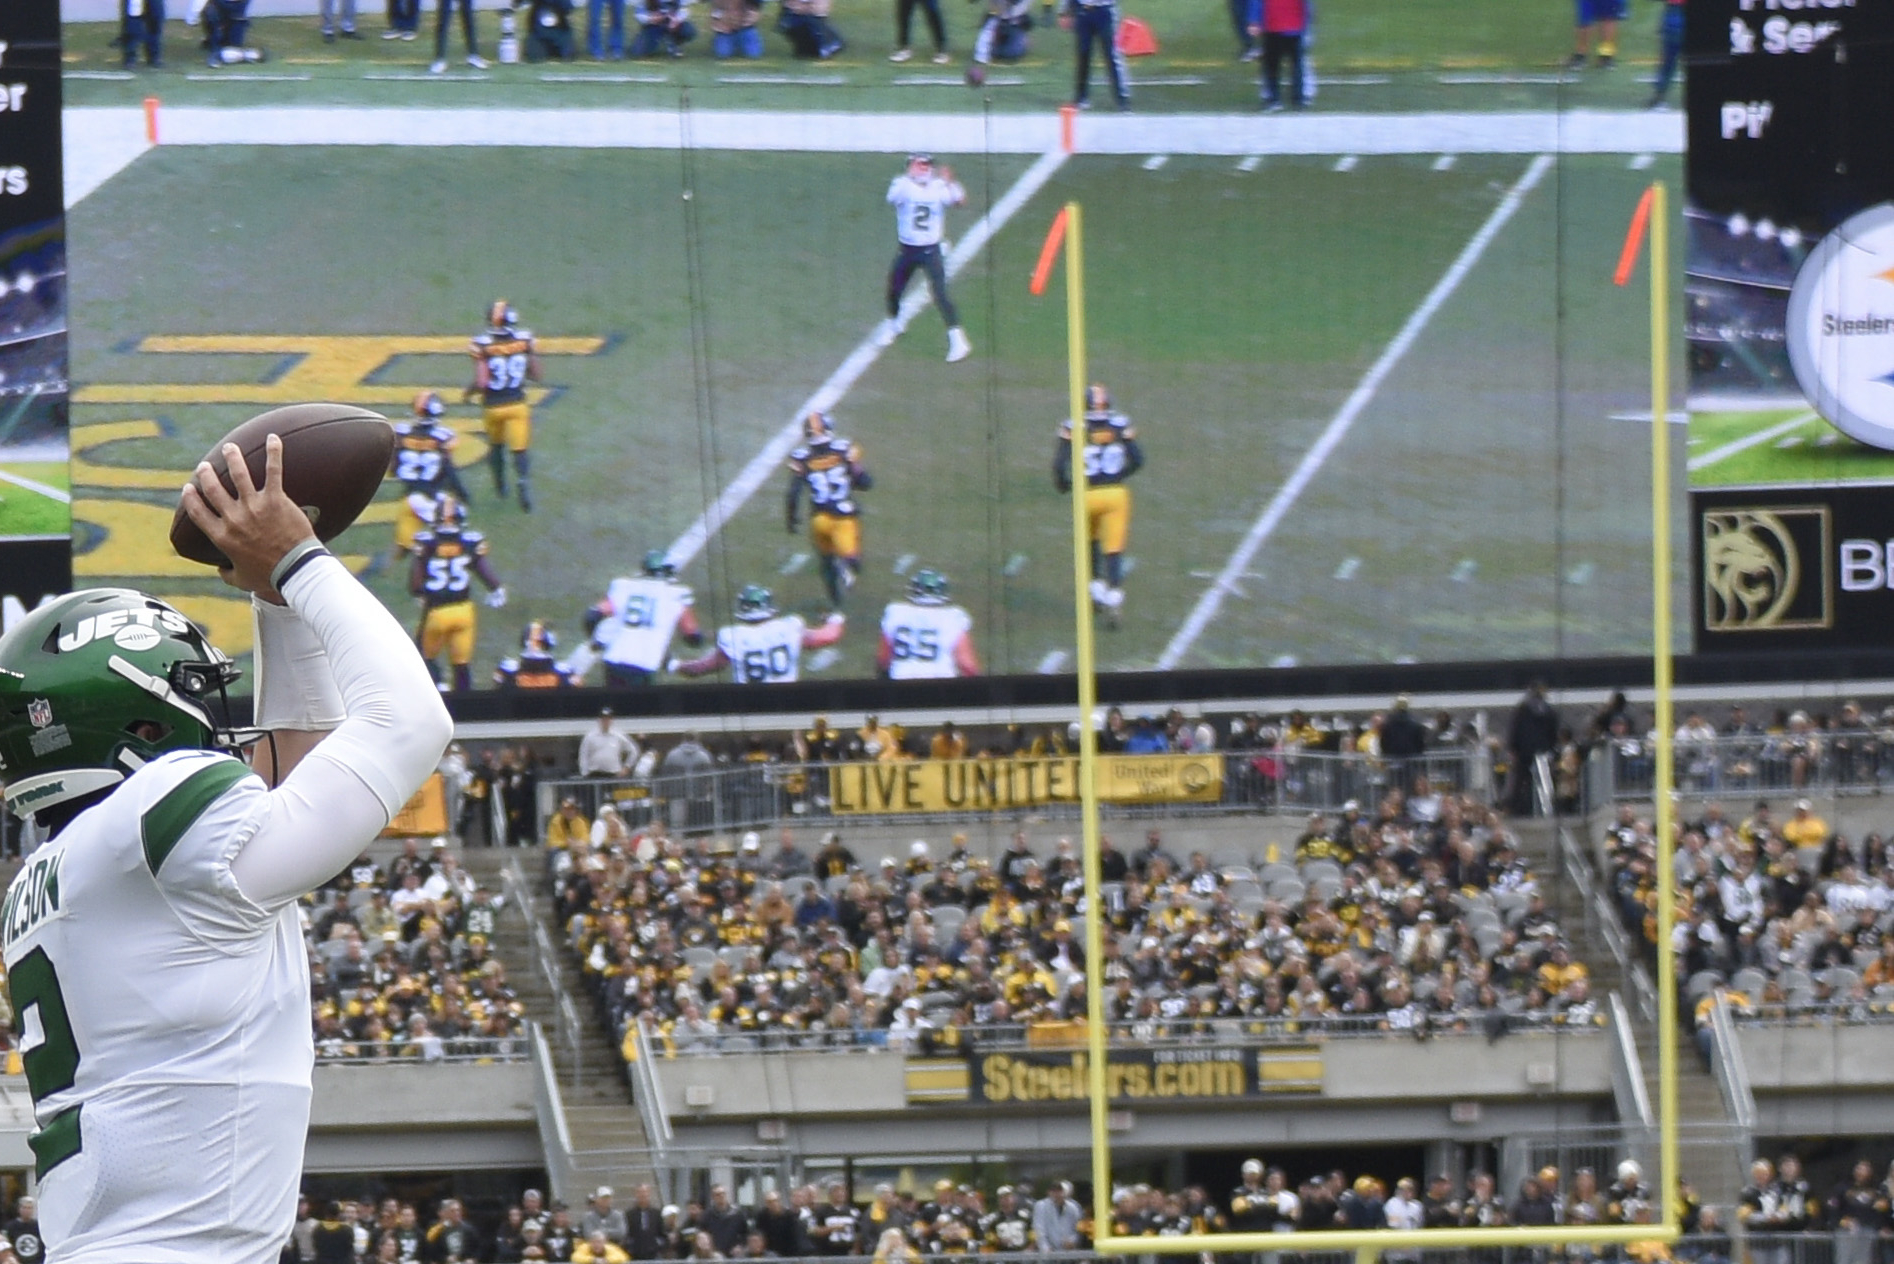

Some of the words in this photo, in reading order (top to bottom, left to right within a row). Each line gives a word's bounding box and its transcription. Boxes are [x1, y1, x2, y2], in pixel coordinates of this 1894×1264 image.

[1823, 311, 1894, 337] Steeler
[425, 556, 470, 591] 55
[1840, 538, 1894, 592] B
[57, 607, 189, 653] JETS
[832, 764, 924, 811] LIVE
